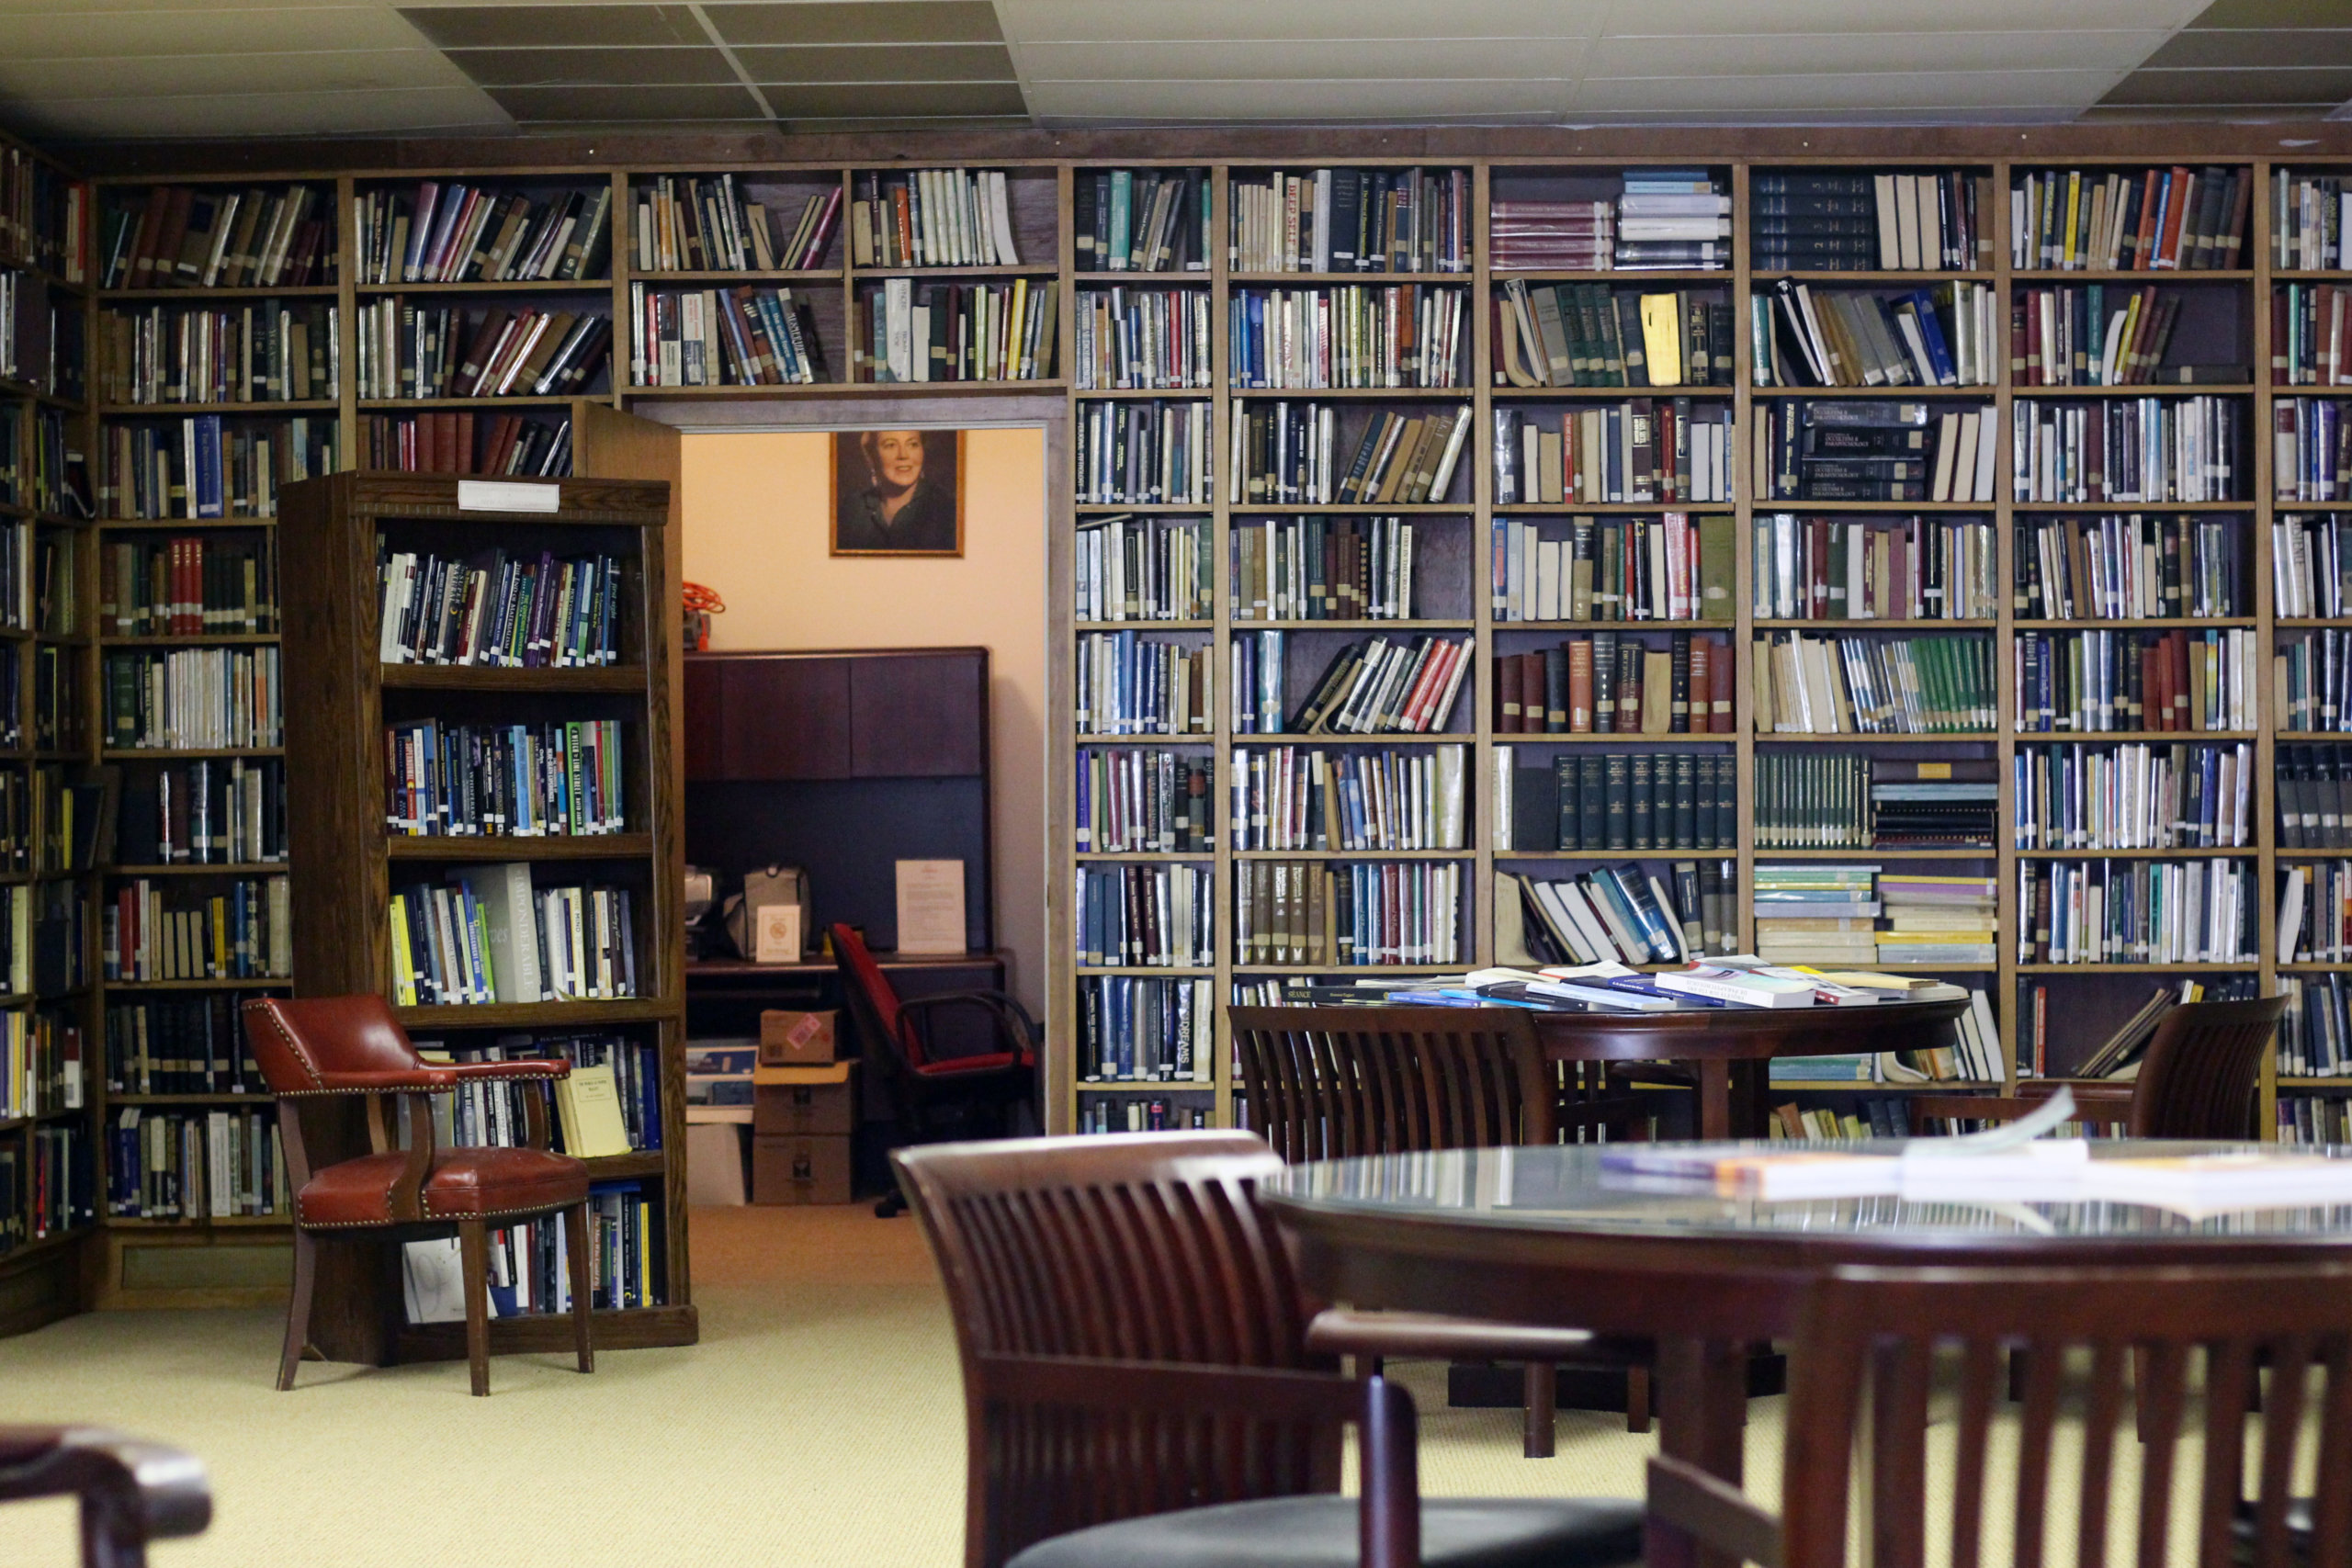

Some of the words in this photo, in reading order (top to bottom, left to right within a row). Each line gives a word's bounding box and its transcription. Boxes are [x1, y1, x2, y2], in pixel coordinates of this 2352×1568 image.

[1288, 185, 1296, 214] DEEP
[1287, 216, 1296, 245] SELF
[782, 340, 791, 357] force
[504, 604, 515, 649] MATERIALISM
[514, 876, 533, 989] IMPONDERABLE
[1180, 1021, 1190, 1064] DREAMS
